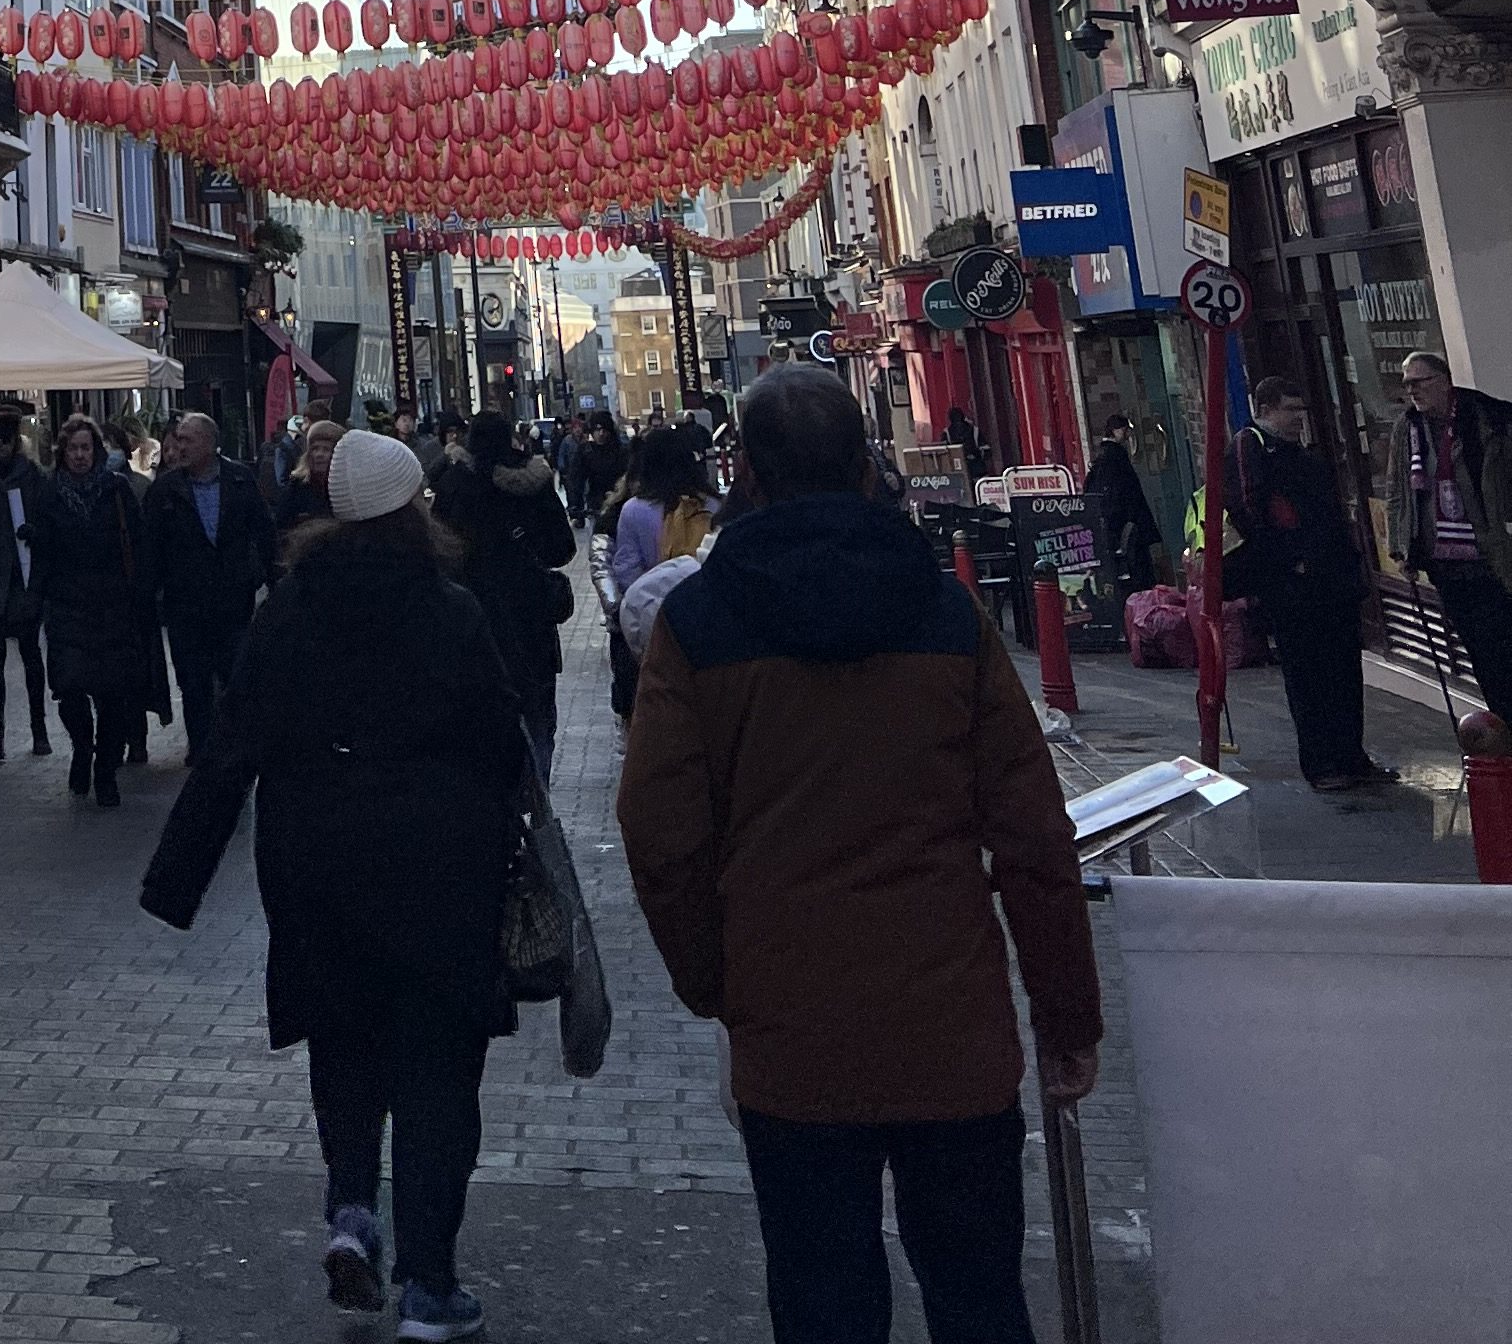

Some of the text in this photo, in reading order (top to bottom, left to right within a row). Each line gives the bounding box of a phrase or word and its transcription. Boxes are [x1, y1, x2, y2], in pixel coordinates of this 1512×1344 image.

[209, 170, 233, 187] 22
[1021, 202, 1098, 221] BETFRED
[965, 257, 1010, 310] O'Neill's
[1192, 280, 1242, 313] 20
[1354, 282, 1383, 322] HOT
[1013, 475, 1062, 491] SUN RISE
[1031, 497, 1086, 517] O'Neill's
[1066, 527, 1095, 548] PASS
